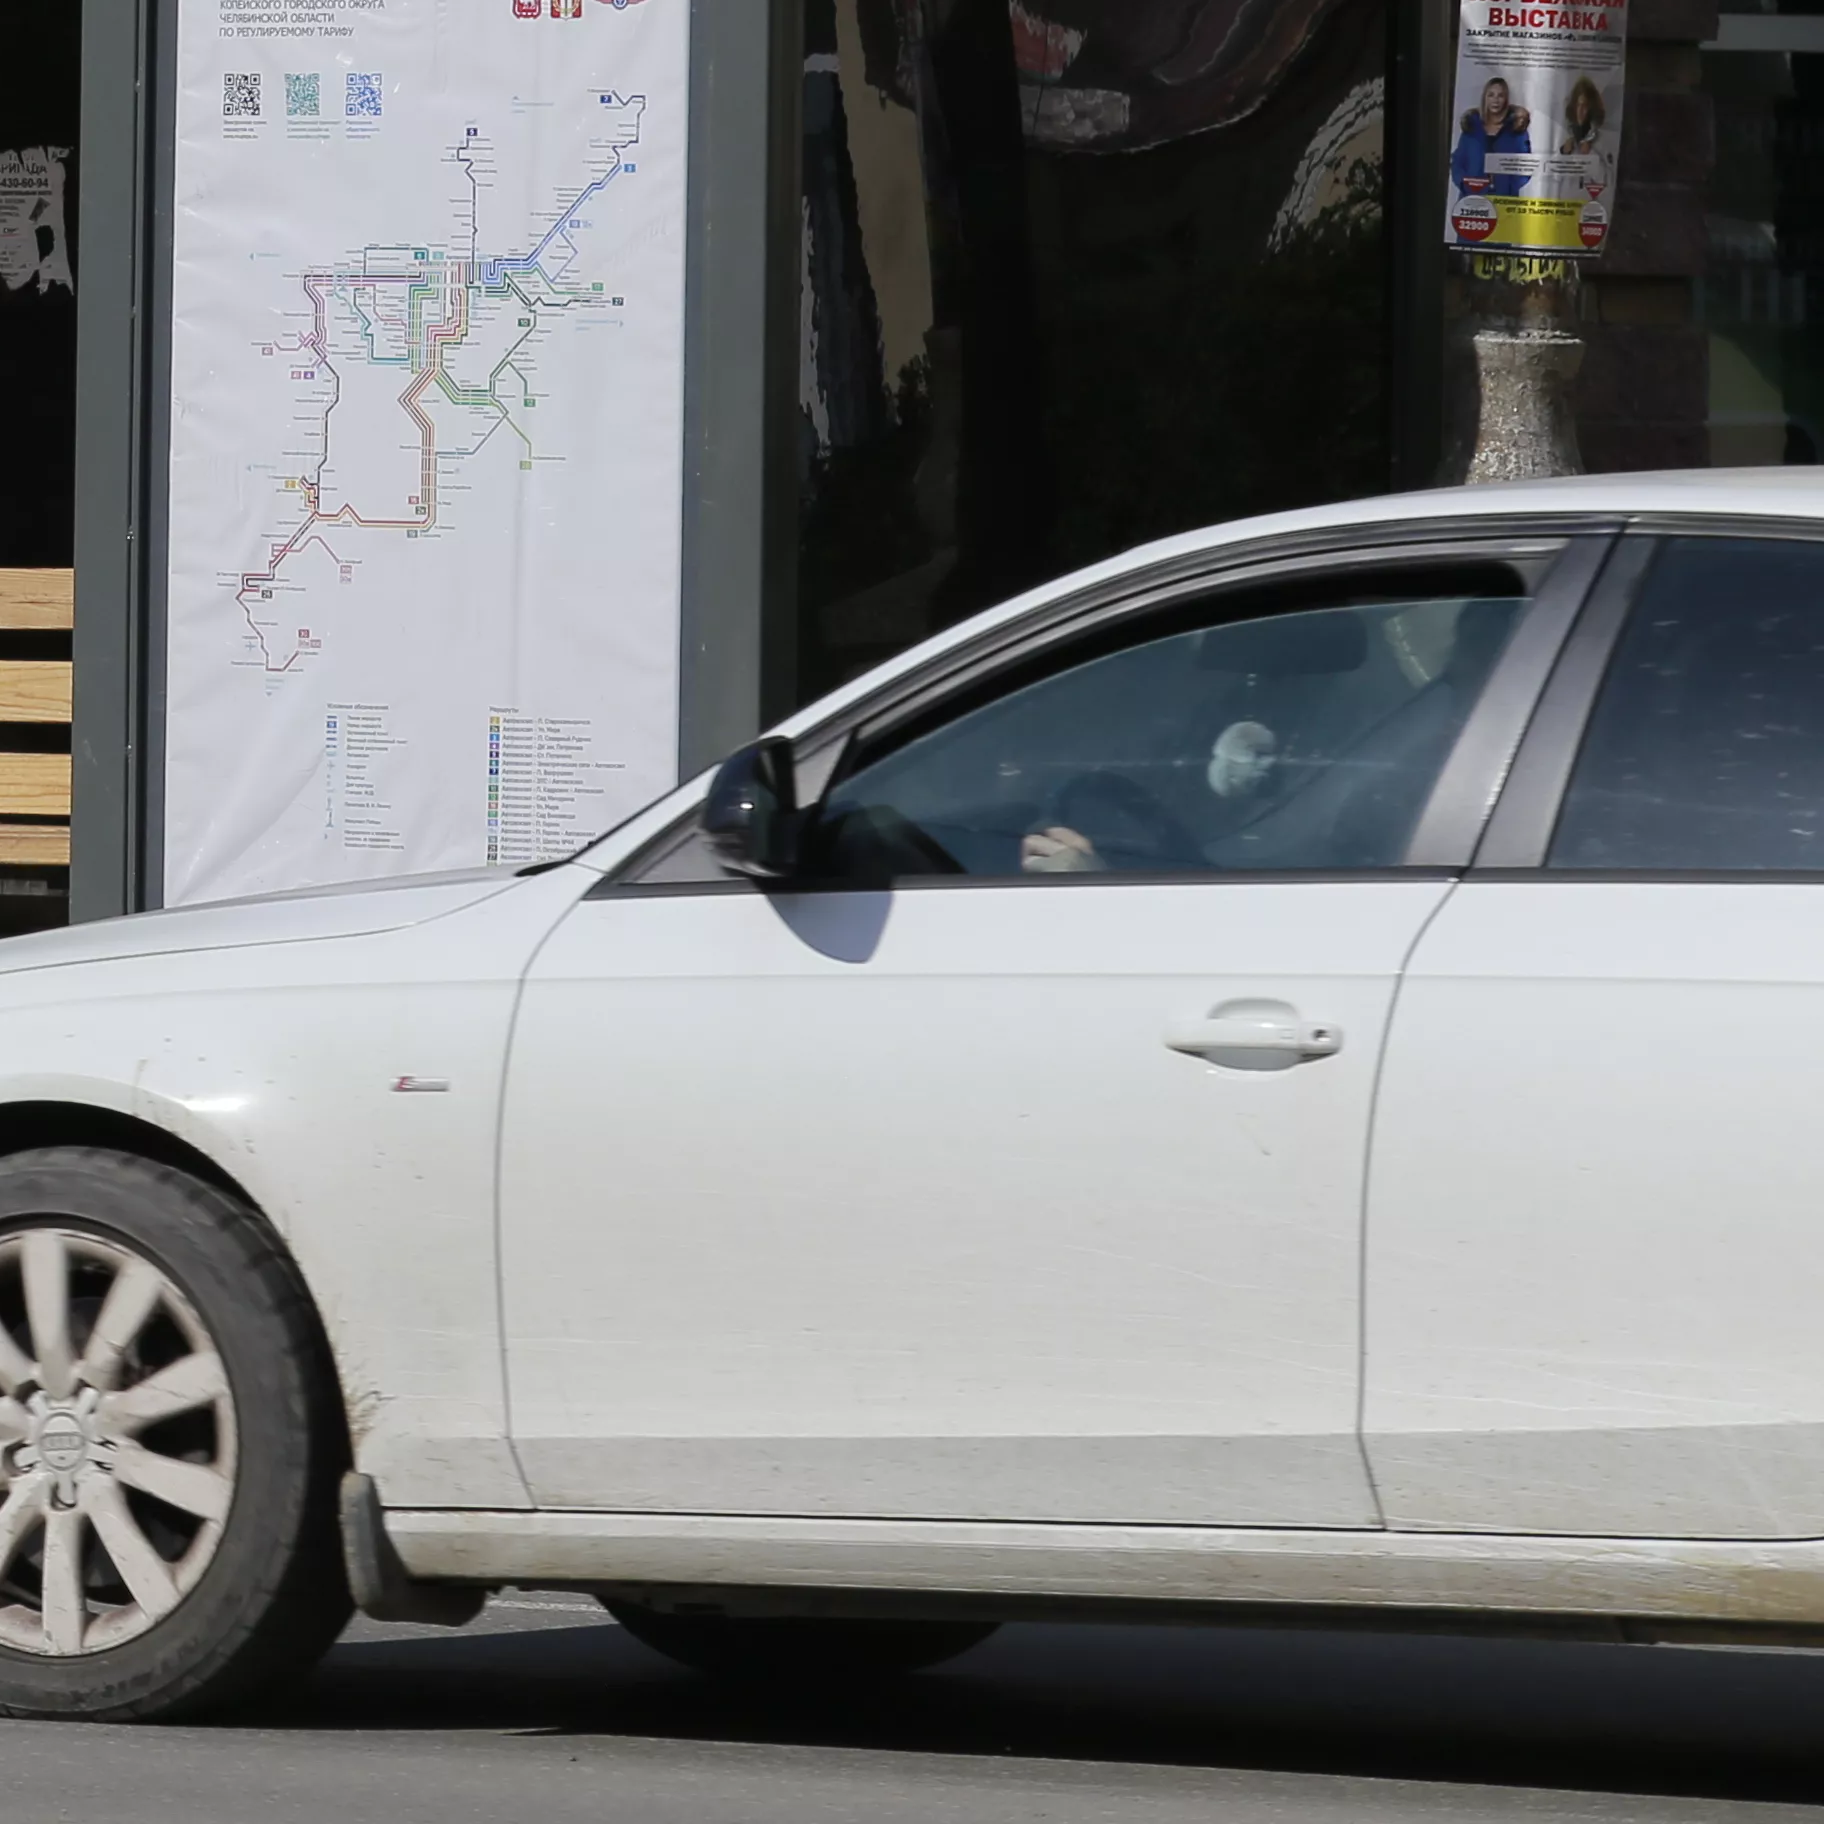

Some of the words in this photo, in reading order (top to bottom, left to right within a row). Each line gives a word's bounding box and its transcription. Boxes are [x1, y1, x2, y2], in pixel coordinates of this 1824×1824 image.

[284, 0, 346, 10] ГОРОДСКОГО
[348, 0, 385, 9] ОКРУГА
[220, 12, 287, 23] ЧЕЛЯБИНСКОЙ
[291, 13, 334, 23] ОБЛАСТИ
[1489, 8, 1608, 31] ВЫСТАВКА
[219, 27, 234, 37] ПО
[237, 27, 315, 37] РЕГУЛИРУЕМОМУ
[318, 27, 354, 36] ТАРИФУ
[1466, 29, 1509, 37] ЗАКРЫТИЕ
[1512, 31, 1563, 40] МАГАЗИНОВ
